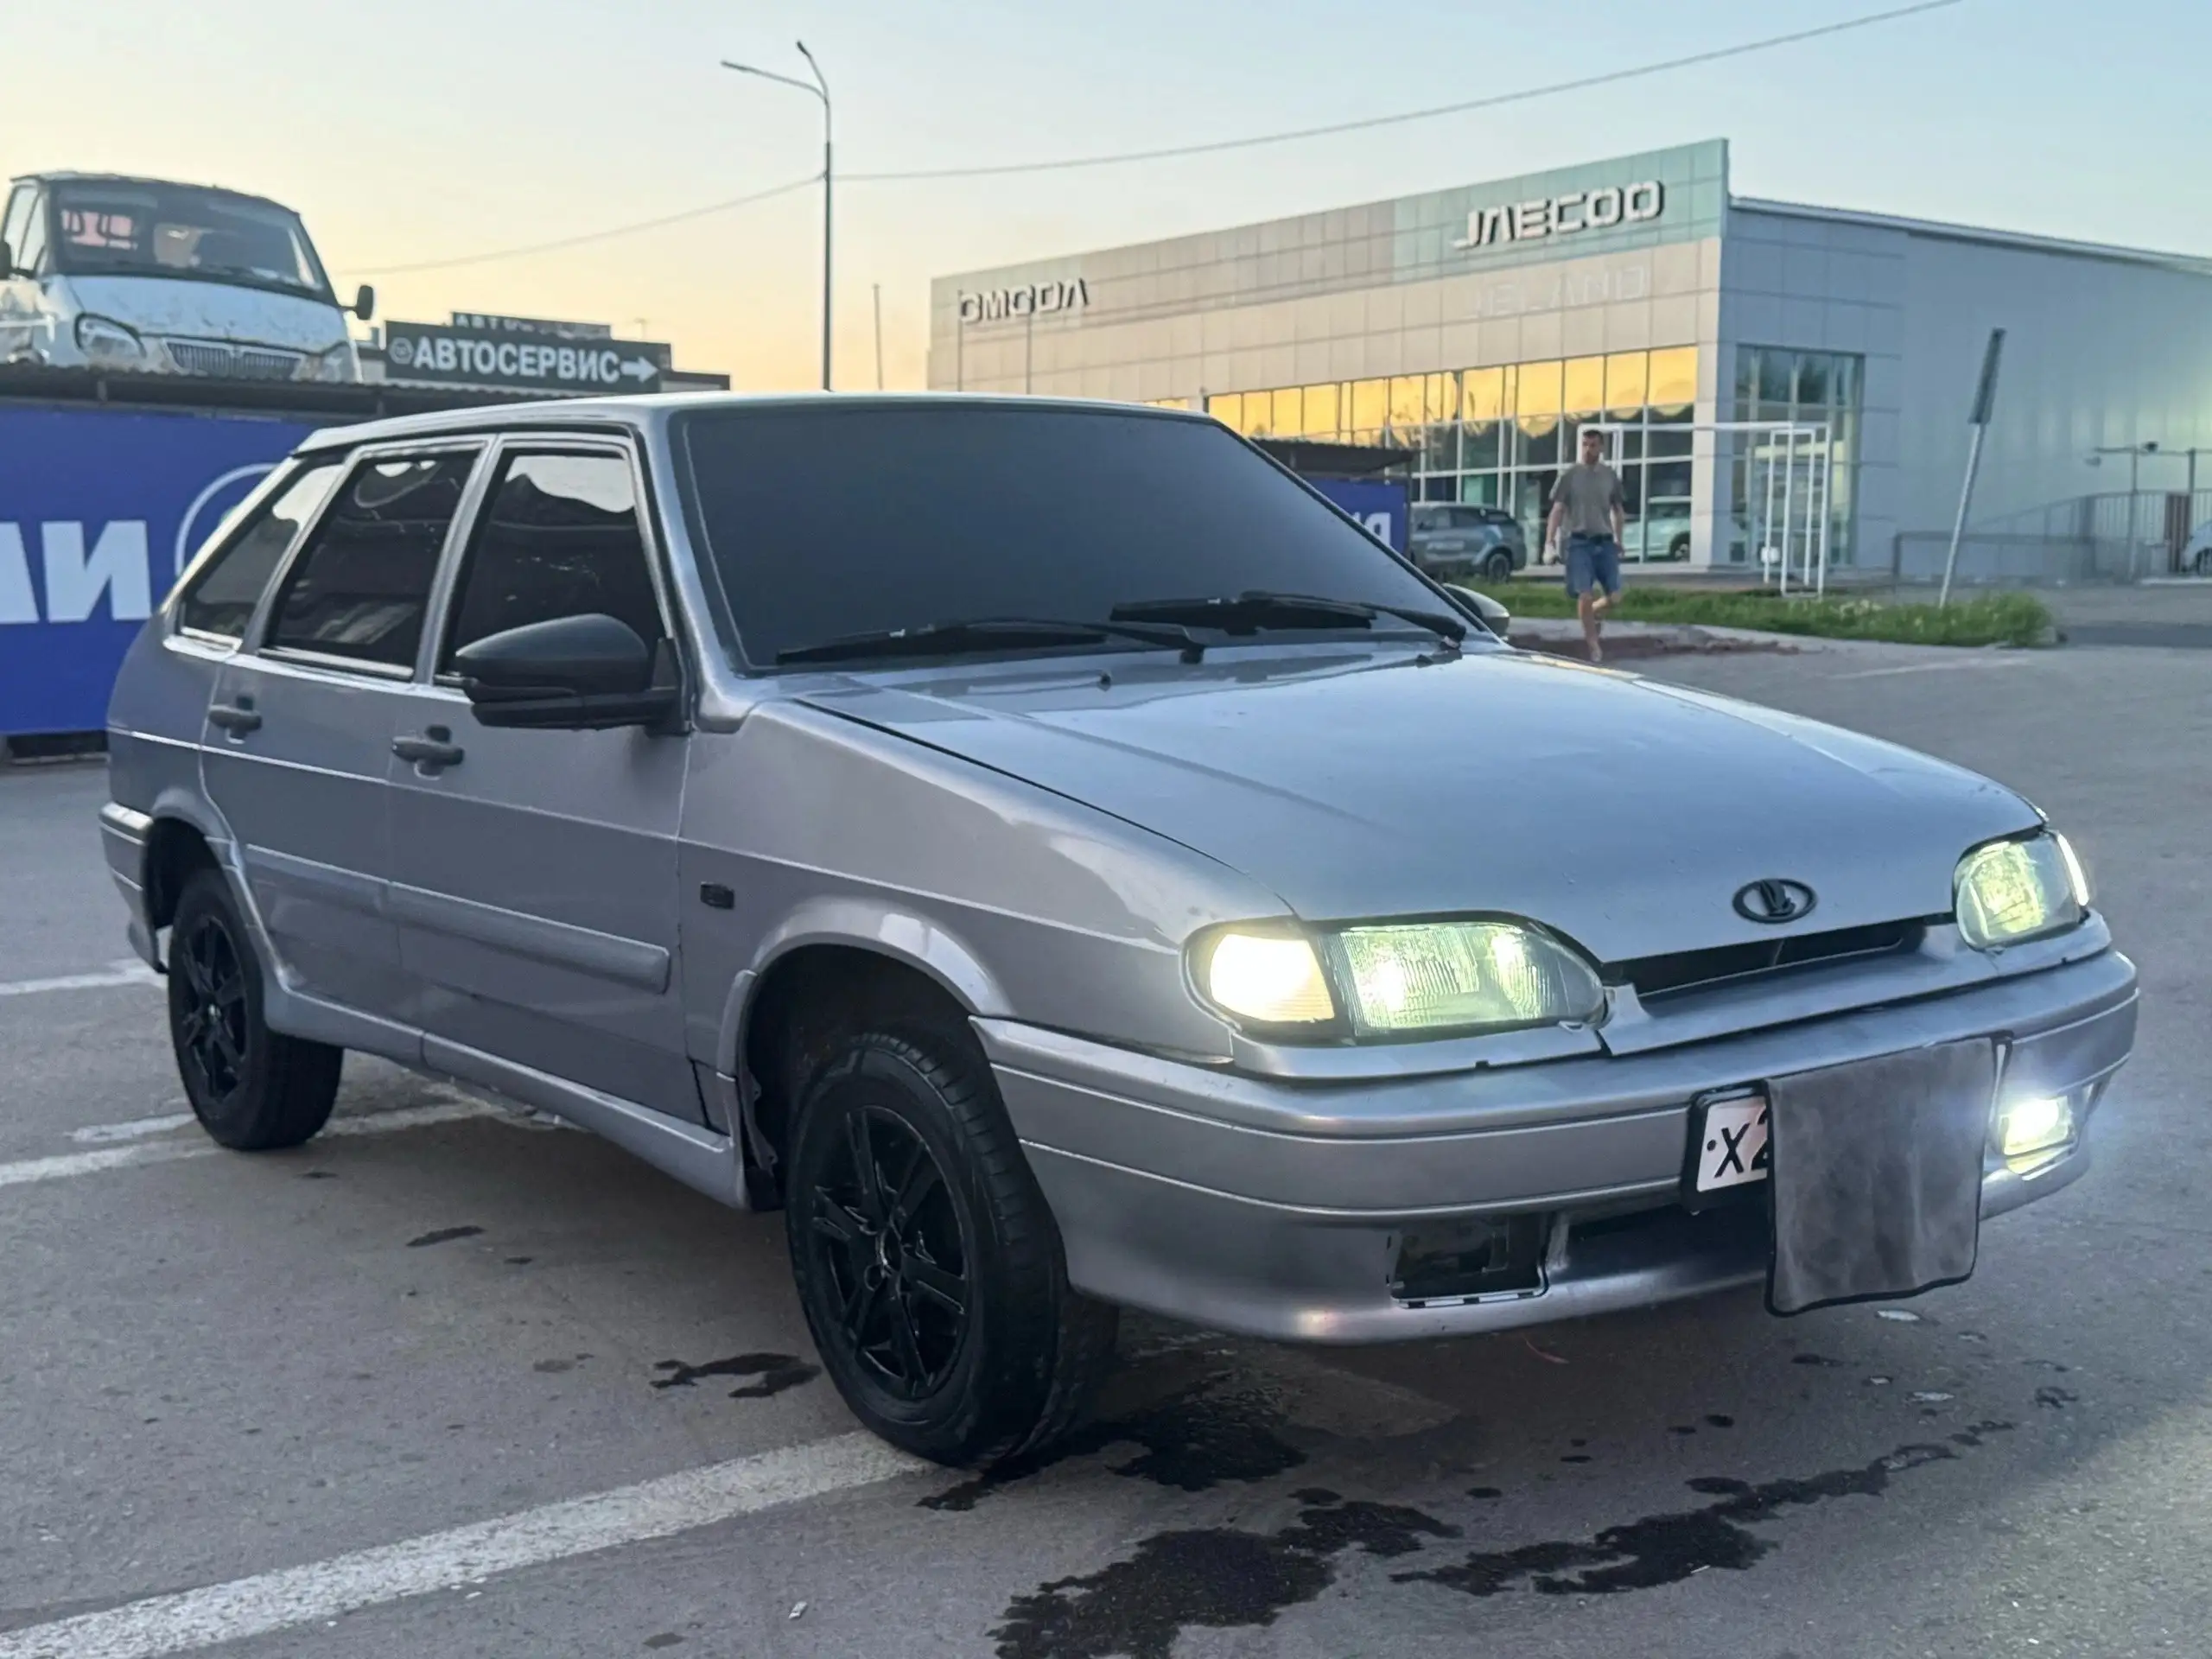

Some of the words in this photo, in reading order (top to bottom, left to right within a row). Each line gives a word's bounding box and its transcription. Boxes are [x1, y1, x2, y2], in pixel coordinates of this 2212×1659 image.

[1452, 180, 1664, 250] JAECOO
[960, 277, 1090, 324] OMODA
[413, 335, 620, 383] АВТОСЕРВИС
